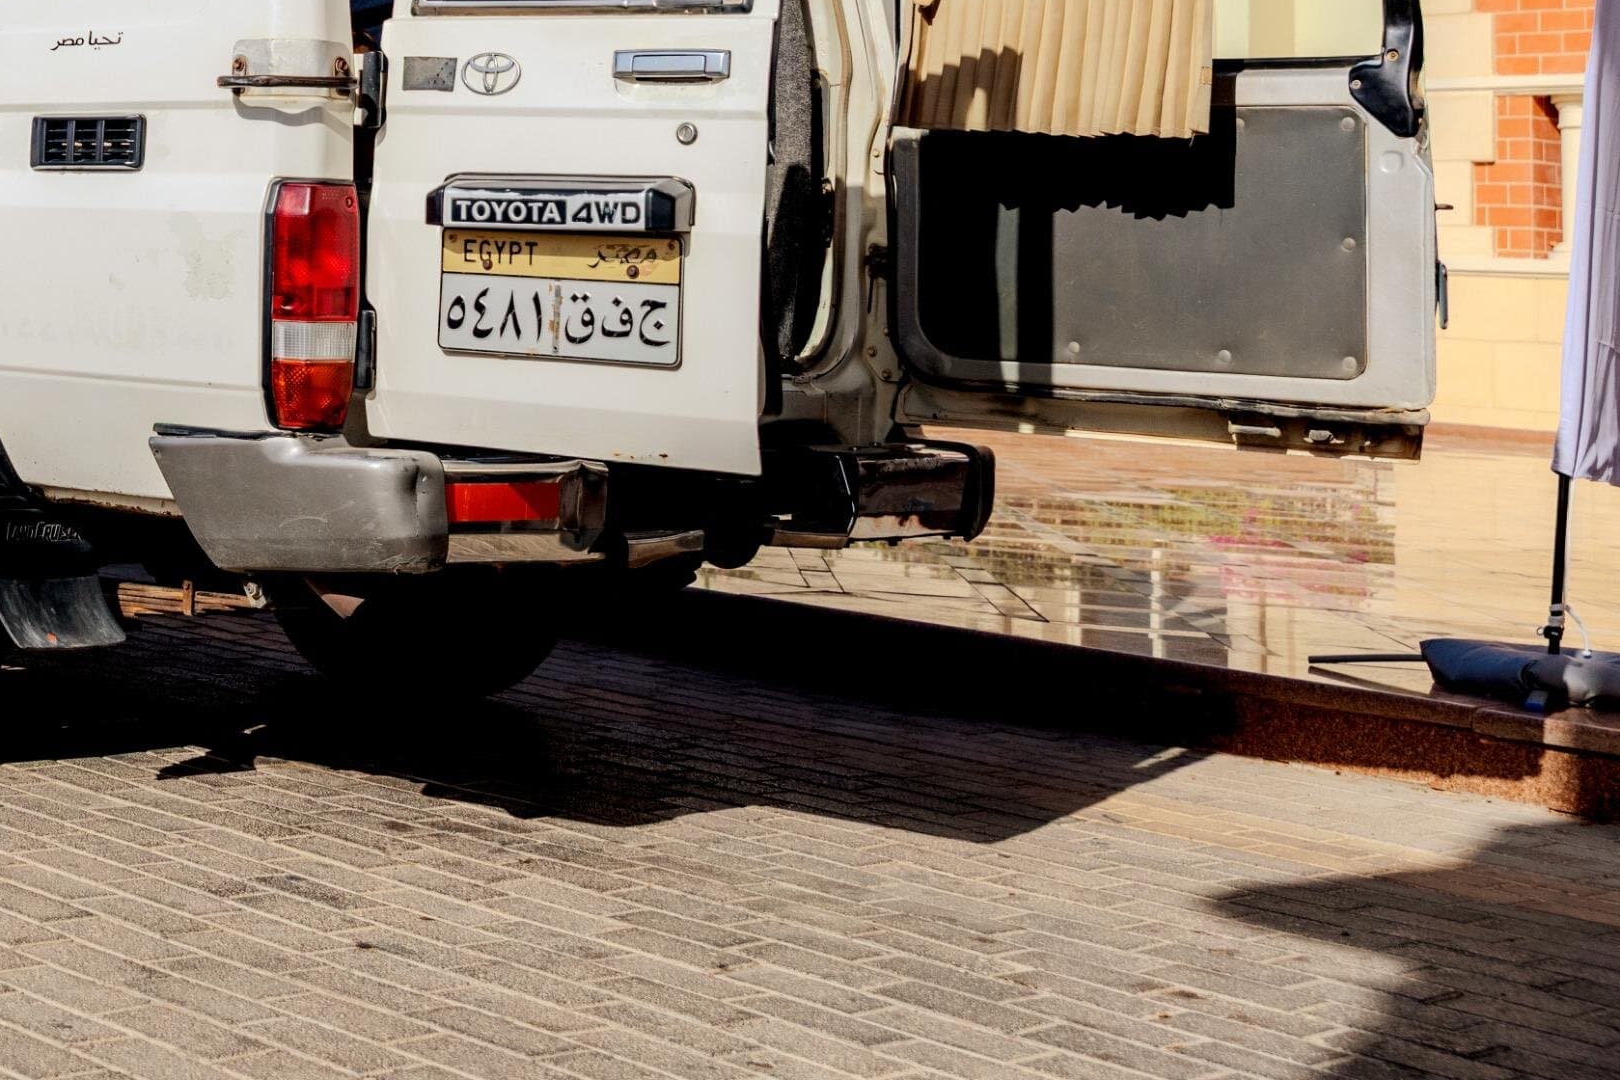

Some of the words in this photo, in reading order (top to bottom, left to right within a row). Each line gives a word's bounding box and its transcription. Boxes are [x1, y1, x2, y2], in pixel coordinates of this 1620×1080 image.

[50, 35, 85, 51] مصر
[456, 200, 561, 222] TOYOTA
[572, 201, 641, 224] 4WD
[463, 239, 538, 266] EGYPT
